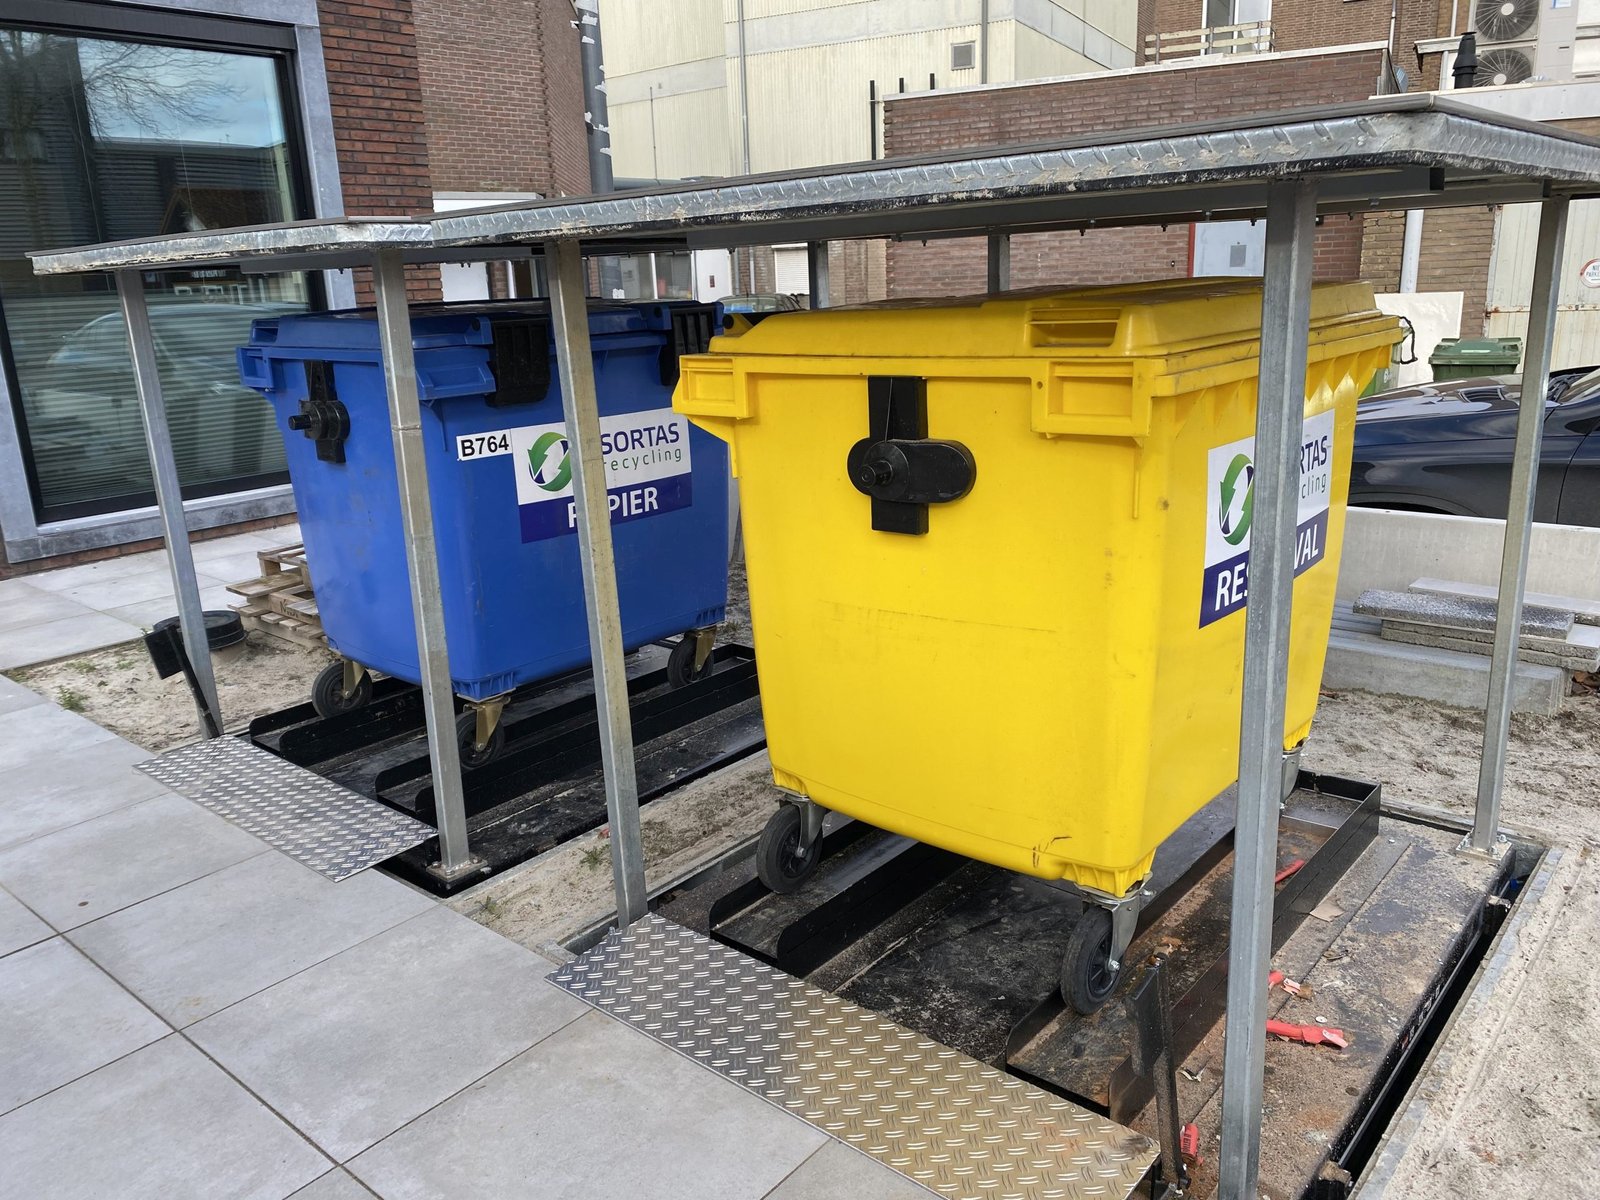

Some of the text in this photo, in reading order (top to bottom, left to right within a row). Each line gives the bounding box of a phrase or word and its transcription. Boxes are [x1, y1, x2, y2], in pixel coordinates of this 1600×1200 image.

[461, 434, 509, 457] B764
[600, 422, 680, 455] SORTAS
[1299, 435, 1328, 475] RTAS
[1301, 473, 1327, 499] cling
[567, 486, 659, 529] PPIER
[1214, 523, 1319, 612] REVAL
